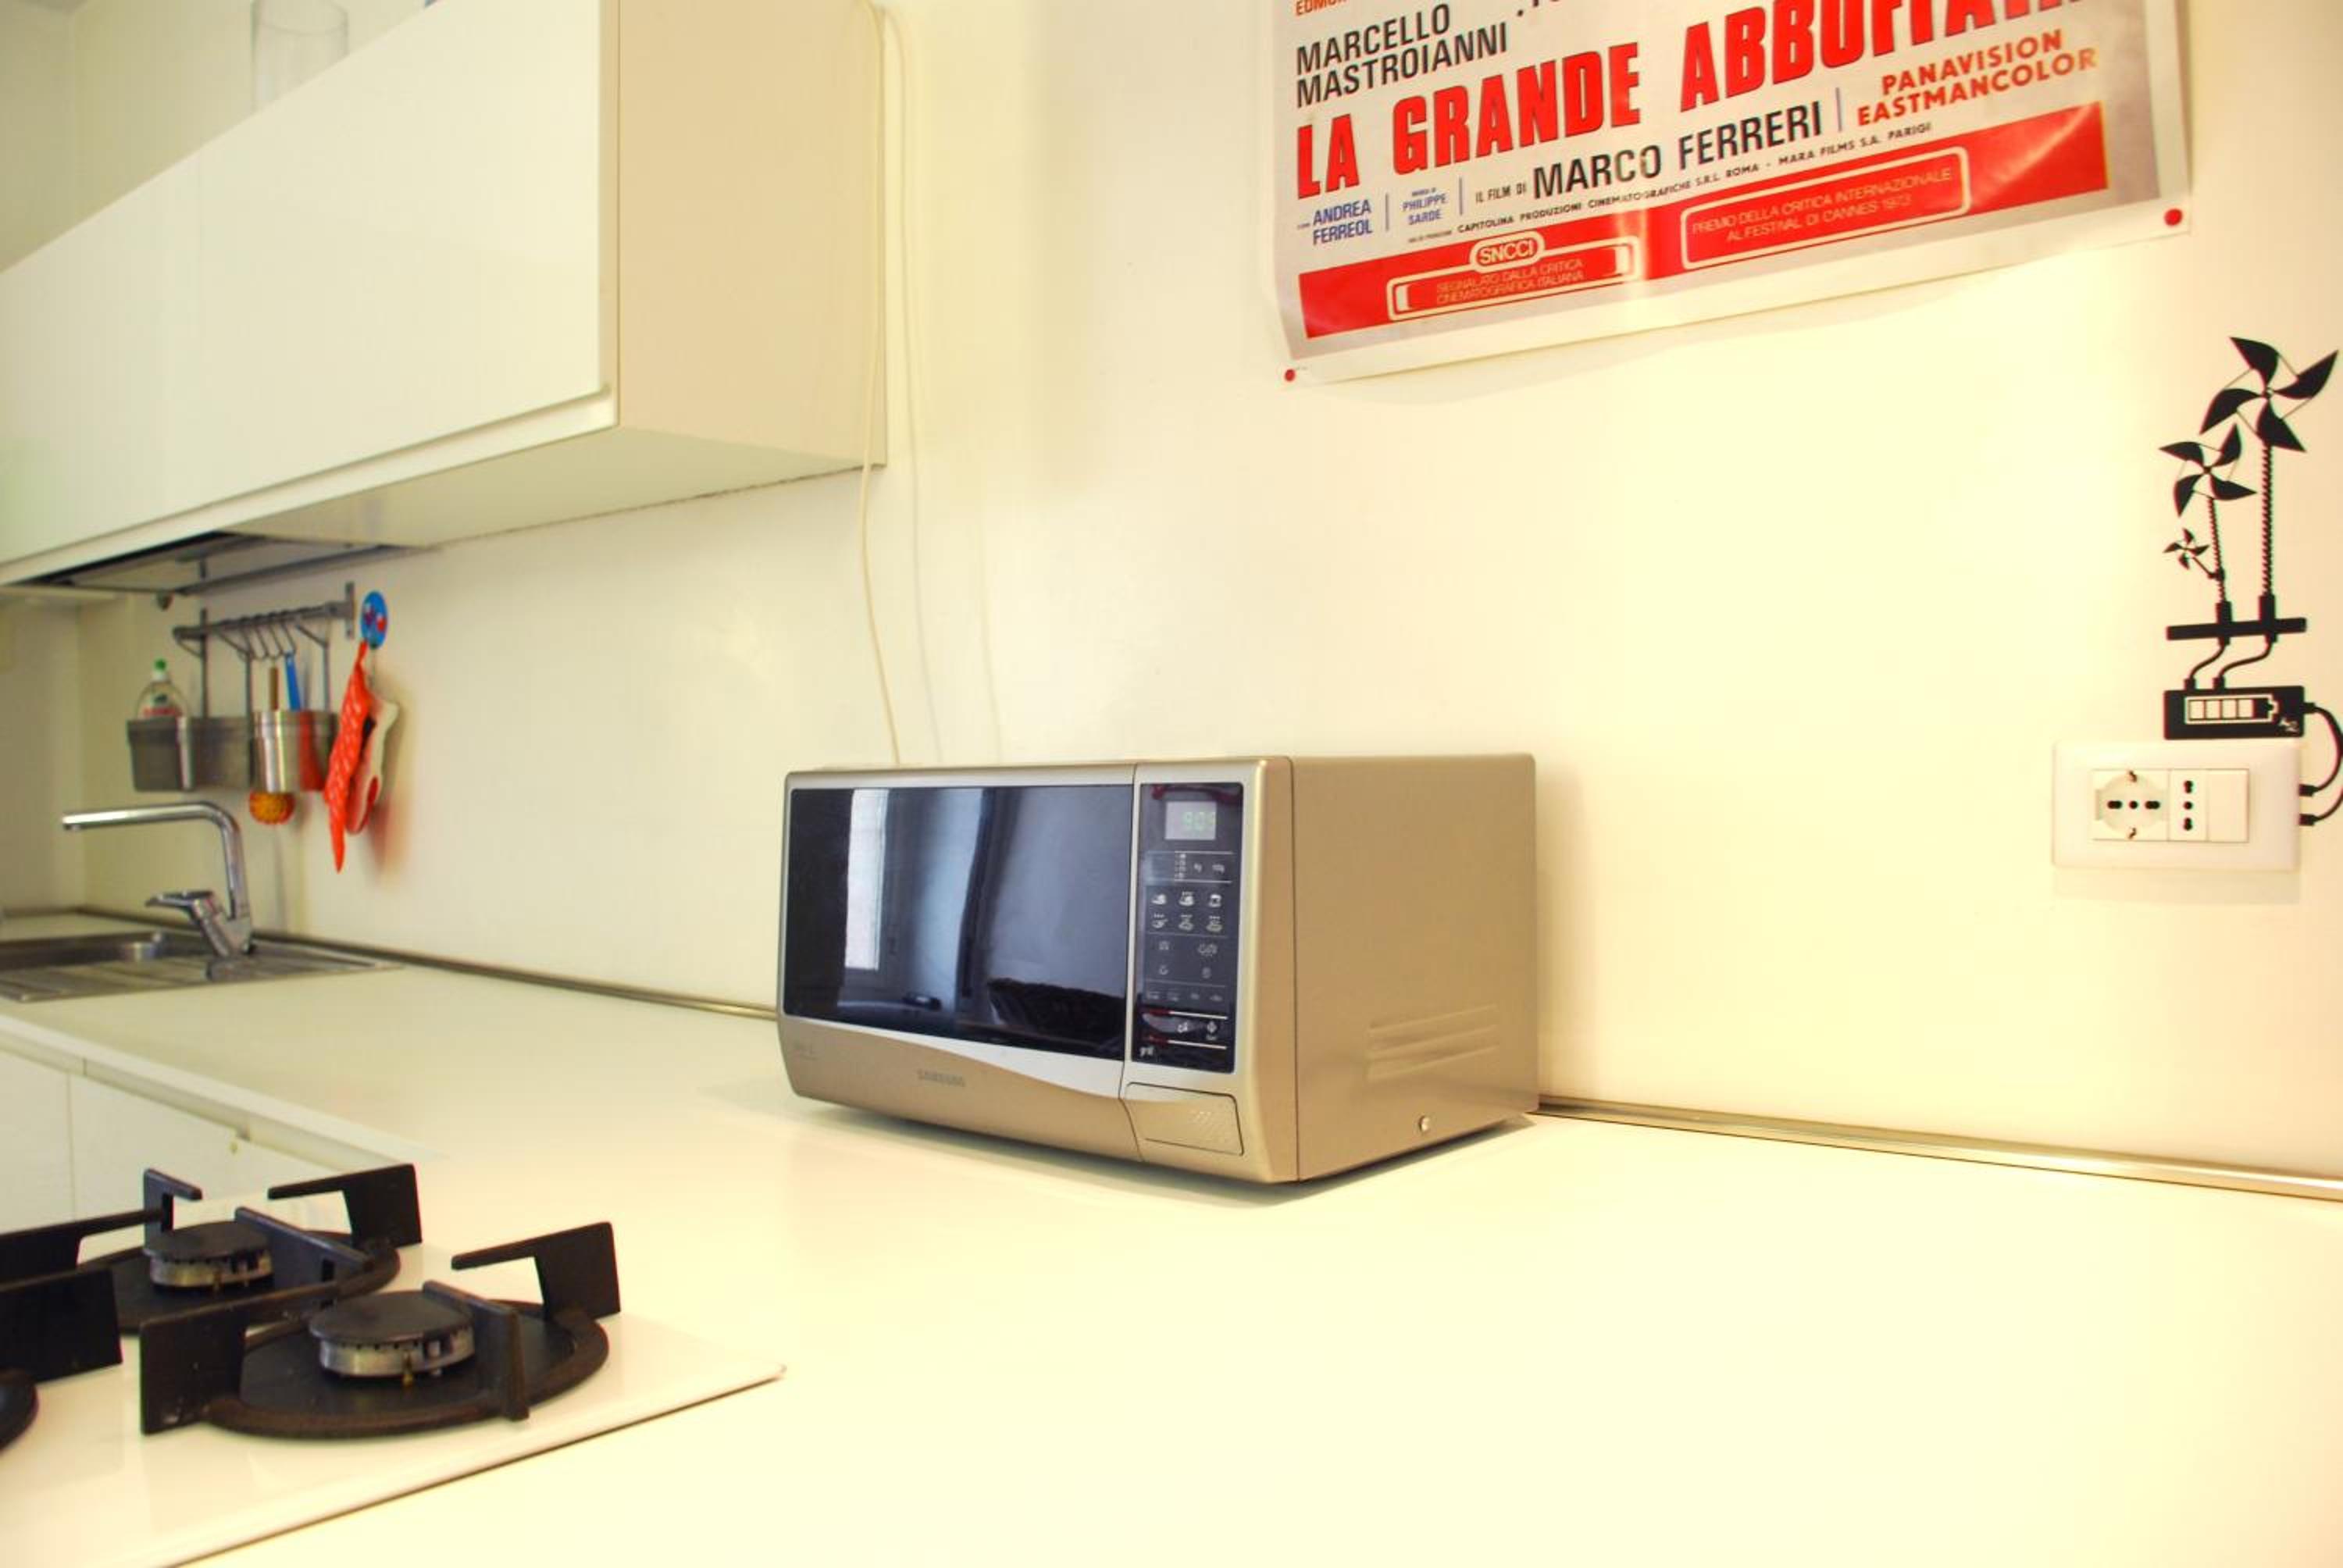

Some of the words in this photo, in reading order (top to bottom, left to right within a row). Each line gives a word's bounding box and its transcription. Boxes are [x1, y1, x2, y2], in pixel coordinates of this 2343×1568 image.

[1296, 4, 1450, 76] MARCELLO
[1297, 22, 1507, 109] MASTROIANNI
[1881, 29, 2062, 95] PANAVISION
[1857, 48, 2097, 127] EASTMANCOLOR
[1297, 113, 1360, 200] LA
[1393, 42, 1640, 176] GRANDE
[1475, 191, 1484, 204] IL
[1487, 185, 1511, 201] FILM
[1517, 181, 1527, 195] DI
[1533, 144, 1661, 200] MARCO
[1678, 101, 1822, 171] FERRERI
[1403, 193, 1448, 212] PHILIPPE
[1457, 216, 1514, 233] CAPITOLINA
[1520, 201, 1582, 222] PRODUZIONI
[1725, 164, 1759, 178] ROMA
[1778, 150, 1814, 166] MARA
[1820, 141, 1855, 158] FILMS
[1887, 122, 1931, 141] PARIGI
[1692, 217, 1736, 234] PREMIO
[1781, 194, 1833, 216] CRITICA
[1835, 167, 1951, 202] INTERNAZIONALE
[1313, 199, 1372, 226] ANDREA
[1313, 219, 1373, 245] FERREOL
[1408, 208, 1443, 225] SARDE
[1806, 213, 1820, 226] DI
[1824, 201, 1878, 224] CANNES
[1478, 241, 1534, 264] SNCCI
